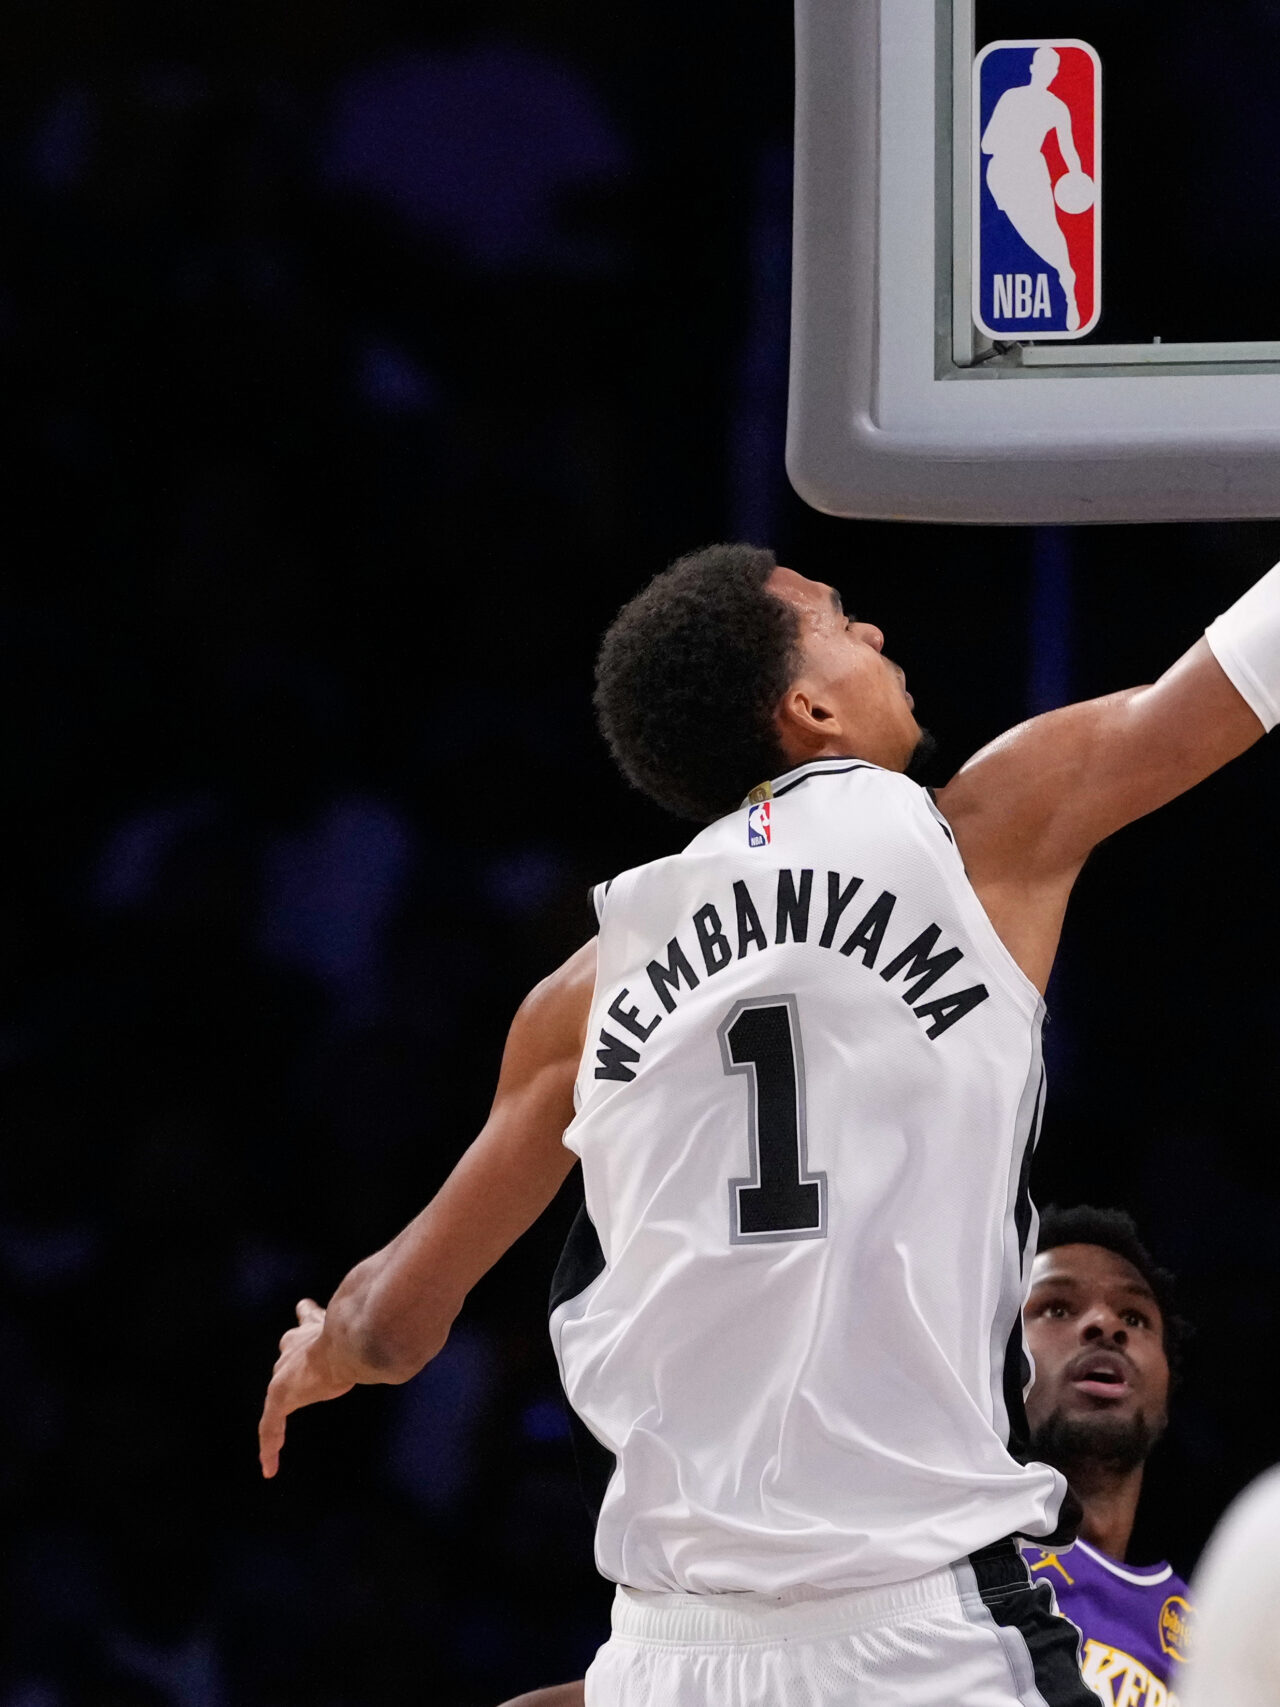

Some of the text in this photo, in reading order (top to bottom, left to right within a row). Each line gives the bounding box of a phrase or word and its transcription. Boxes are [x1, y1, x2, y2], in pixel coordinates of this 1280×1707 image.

[993, 273, 1052, 319] NBA
[751, 836, 764, 846] NBA
[594, 868, 990, 1082] WEMBANYAMA
[717, 993, 828, 1245] 1
[1082, 1638, 1180, 1707] KER
